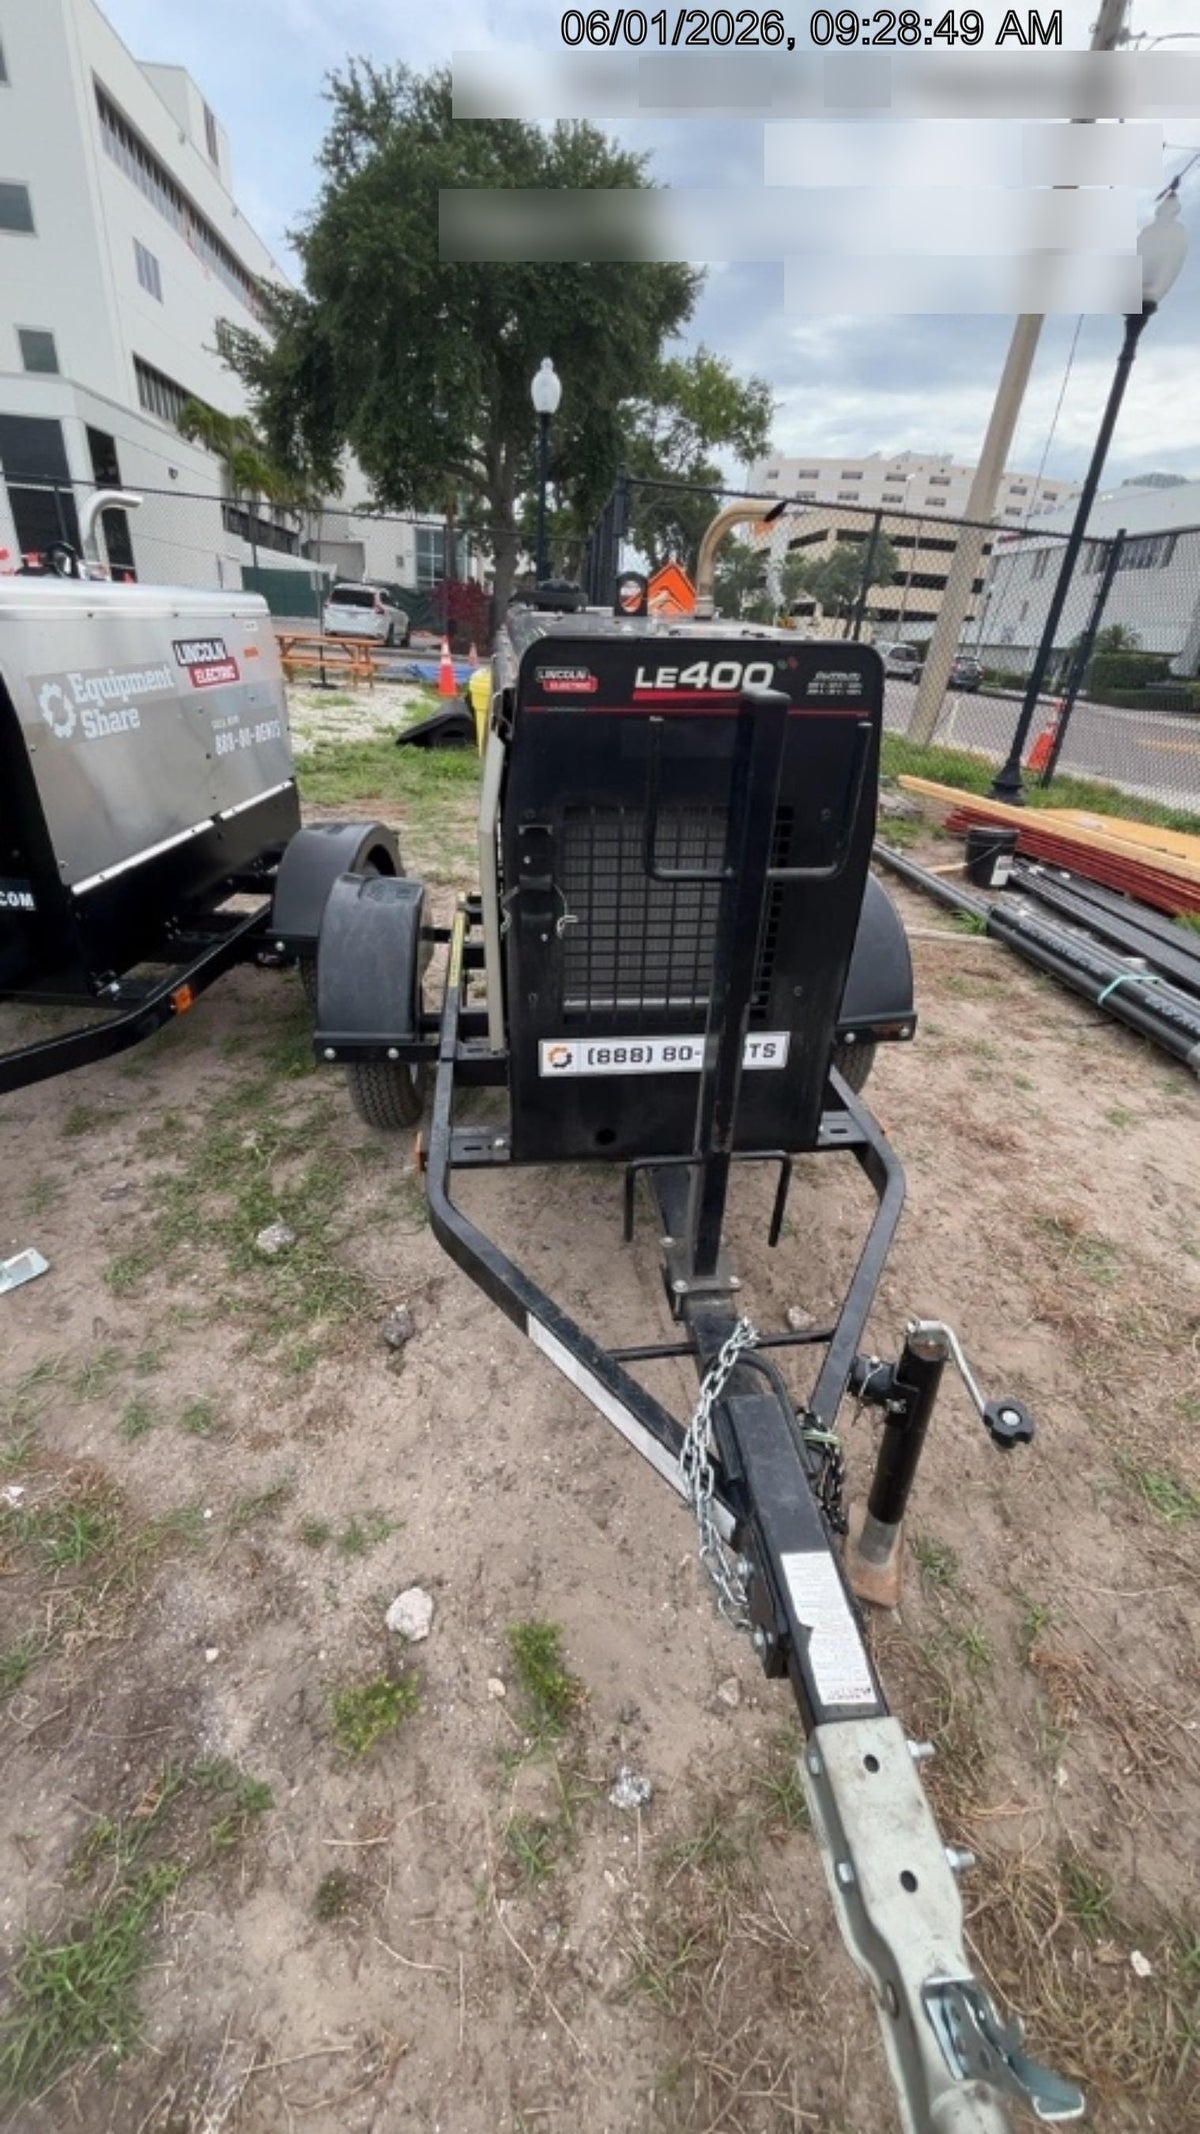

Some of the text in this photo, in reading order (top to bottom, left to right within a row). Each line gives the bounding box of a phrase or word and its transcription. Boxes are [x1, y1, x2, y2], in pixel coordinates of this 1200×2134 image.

[174, 641, 227, 665] LINCOLN
[66, 664, 176, 707] Equipment
[634, 661, 774, 690] LE400
[81, 707, 141, 739] Share
[587, 1045, 653, 1065] (888)
